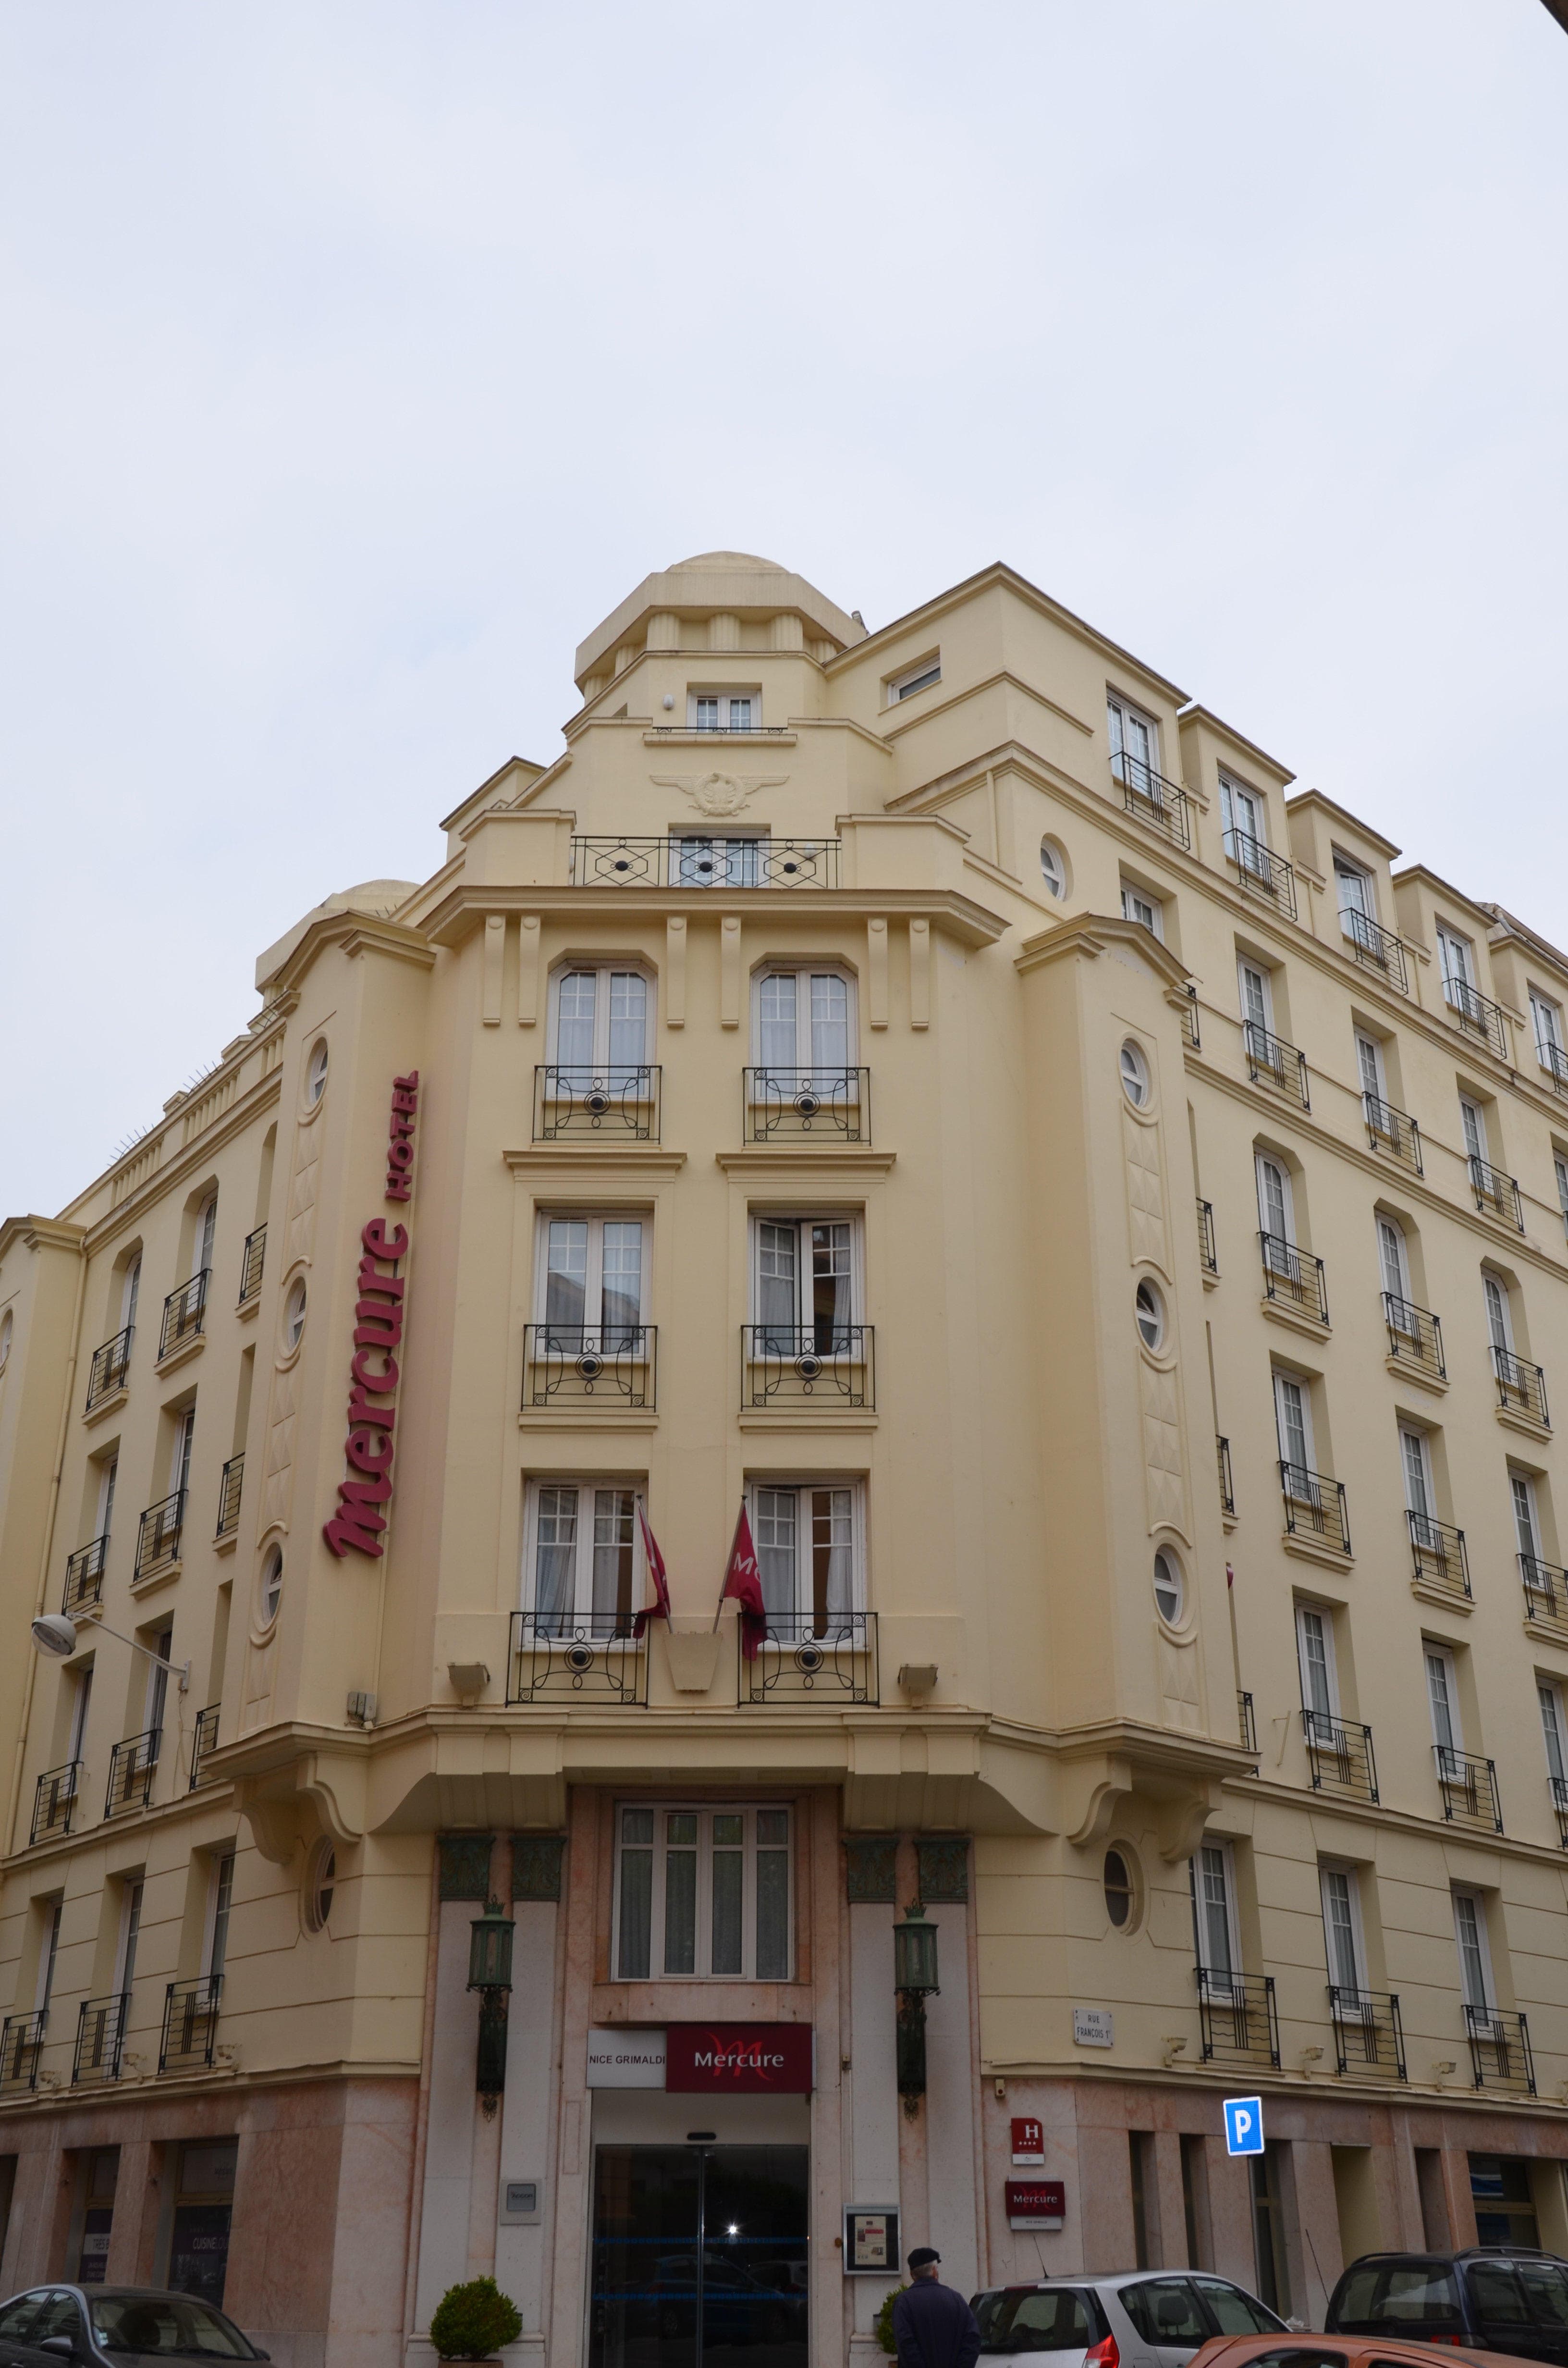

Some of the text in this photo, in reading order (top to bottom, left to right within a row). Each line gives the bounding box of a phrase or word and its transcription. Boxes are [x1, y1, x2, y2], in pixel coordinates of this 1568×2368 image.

[323, 1070, 419, 1559] Mercure HOTEL
[1088, 2014, 1100, 2023] RUE
[589, 2055, 665, 2064] NICE GRIMALDI
[695, 2052, 784, 2067] Mercure
[1025, 2125, 1039, 2138] H
[1235, 2110, 1252, 2144] P
[1013, 2194, 1058, 2204] Mercure
